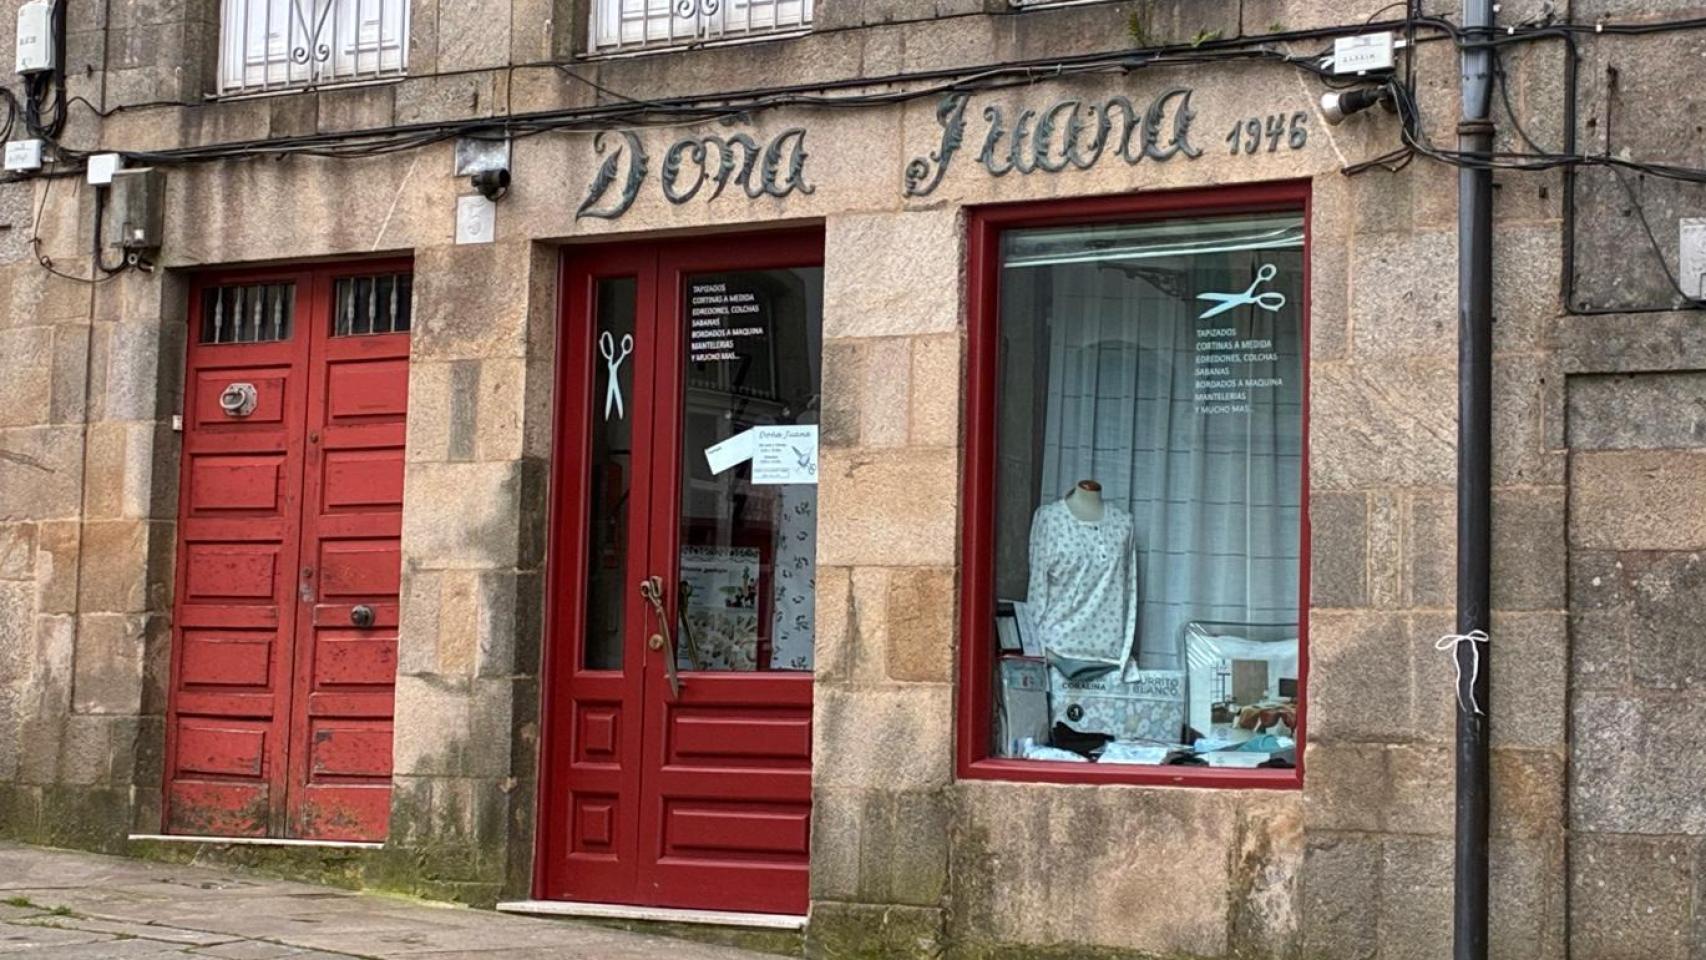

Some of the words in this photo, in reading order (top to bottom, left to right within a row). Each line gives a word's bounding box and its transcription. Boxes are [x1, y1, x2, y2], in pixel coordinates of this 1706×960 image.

[902, 87, 1203, 198] Juana
[1226, 109, 1309, 155] 1946
[693, 284, 726, 293] TAPIZADOS
[693, 296, 722, 304] CORTINAS
[723, 295, 729, 303] A
[729, 293, 755, 303] MEDIDA
[731, 305, 759, 313] COLCHAS
[691, 328, 726, 339] BORDADOS
[726, 328, 732, 336] A
[1196, 328, 1237, 338] TAPIZADOS
[1195, 341, 1233, 351] CORTINAS
[1234, 340, 1240, 349] A
[1241, 339, 1272, 349] MEDIDA
[691, 354, 696, 362] Y
[696, 352, 721, 361] MUCHO
[1243, 352, 1278, 362] COLCHAS
[1195, 380, 1236, 389] BORDADOS
[1238, 379, 1244, 387] A
[1194, 406, 1199, 414] Y
[1200, 405, 1231, 414] MUCHO
[1138, 676, 1180, 687] URRITO
[1132, 685, 1179, 697] BLANCO
